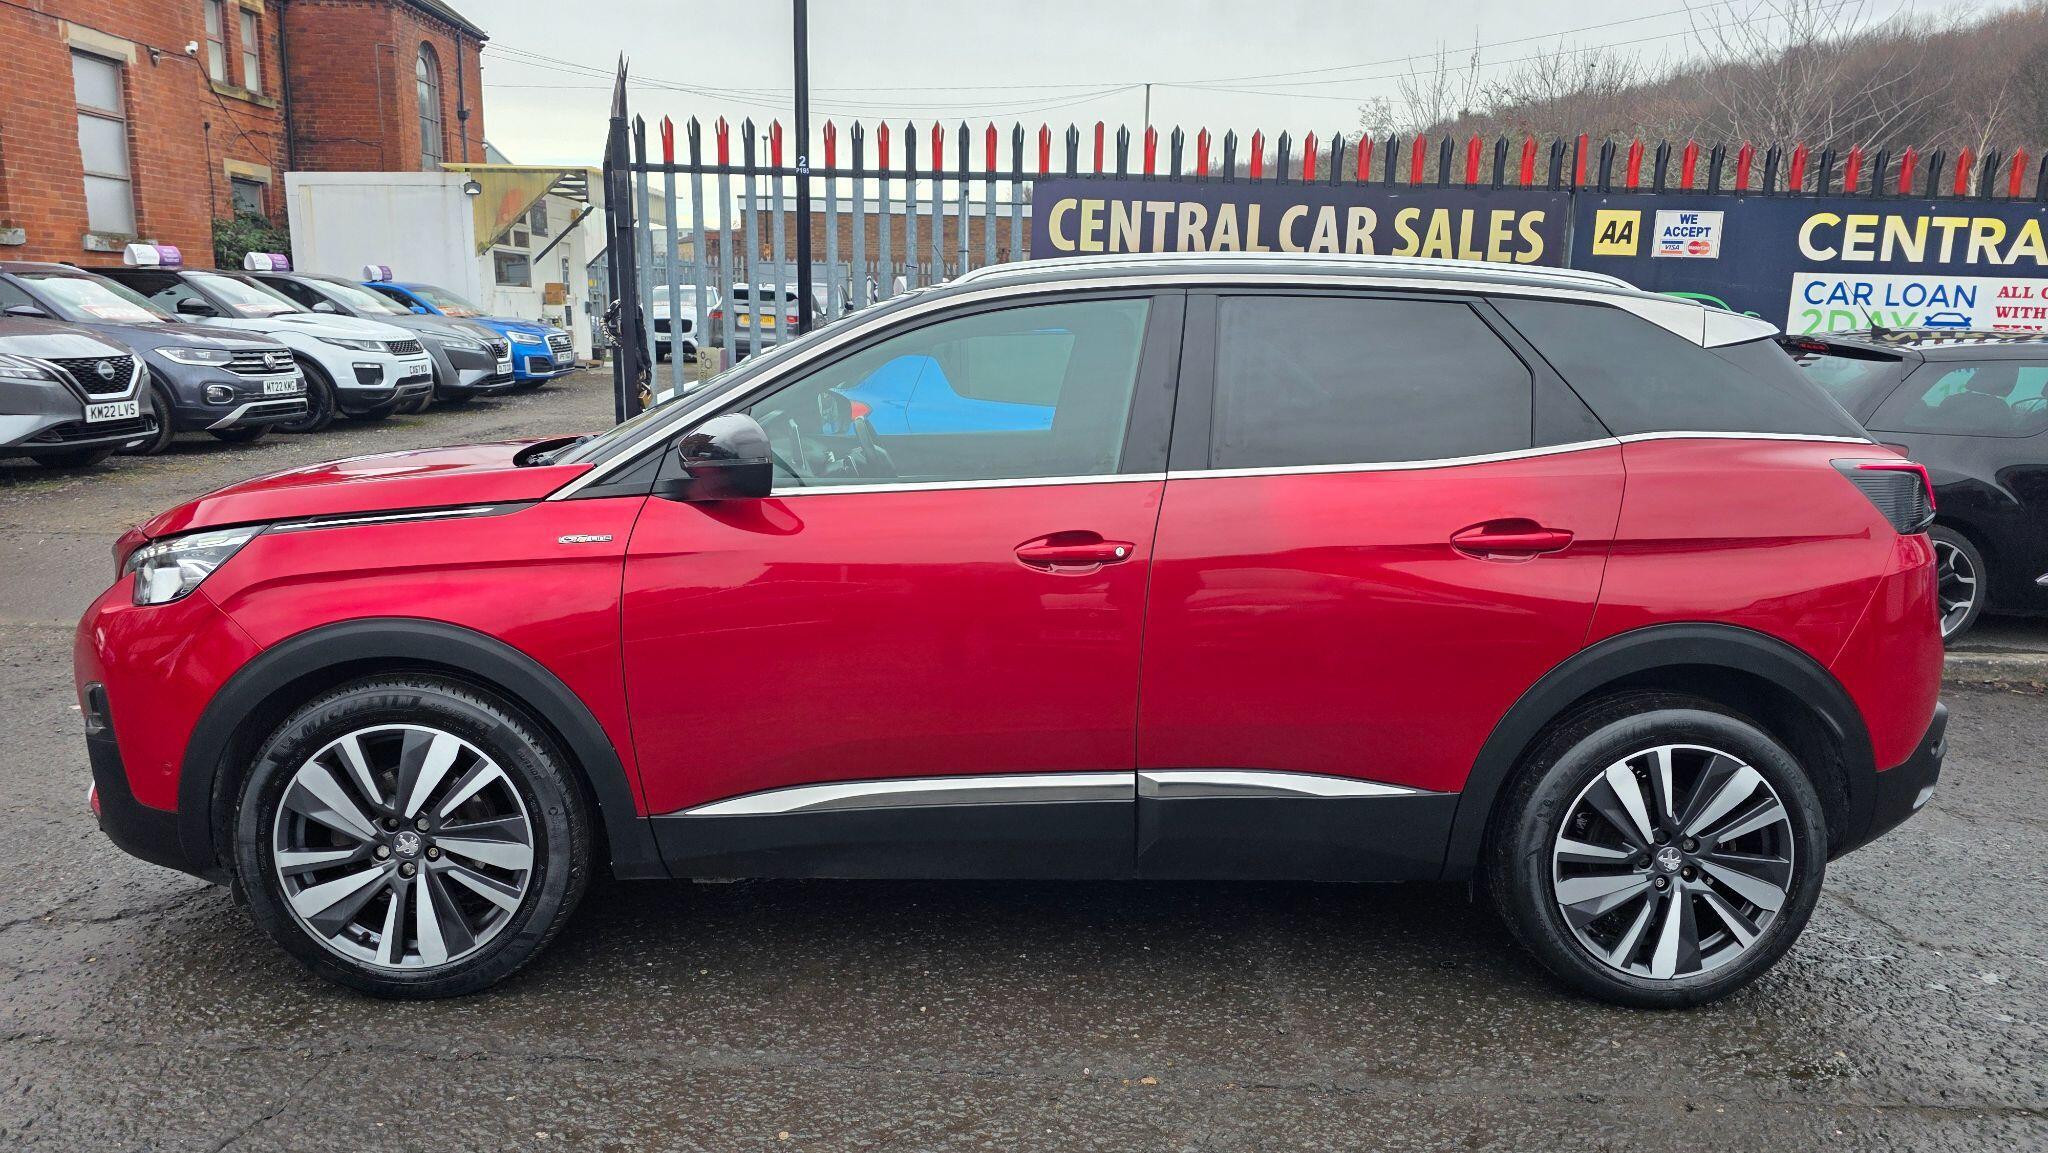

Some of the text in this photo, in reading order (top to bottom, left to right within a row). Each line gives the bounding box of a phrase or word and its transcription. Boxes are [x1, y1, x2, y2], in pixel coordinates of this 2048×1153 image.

[798, 155, 807, 167] 2
[1680, 213, 1698, 225] WE
[1049, 198, 1546, 264] CENTRAL CAR SALES
[1598, 220, 1634, 245] AA
[1664, 226, 1711, 238] ACCEPT
[1804, 280, 1978, 309] CAR LOAN
[1997, 286, 2034, 299] ALL
[1995, 306, 2048, 319] WITH
[91, 403, 136, 419] KM22 LVS
